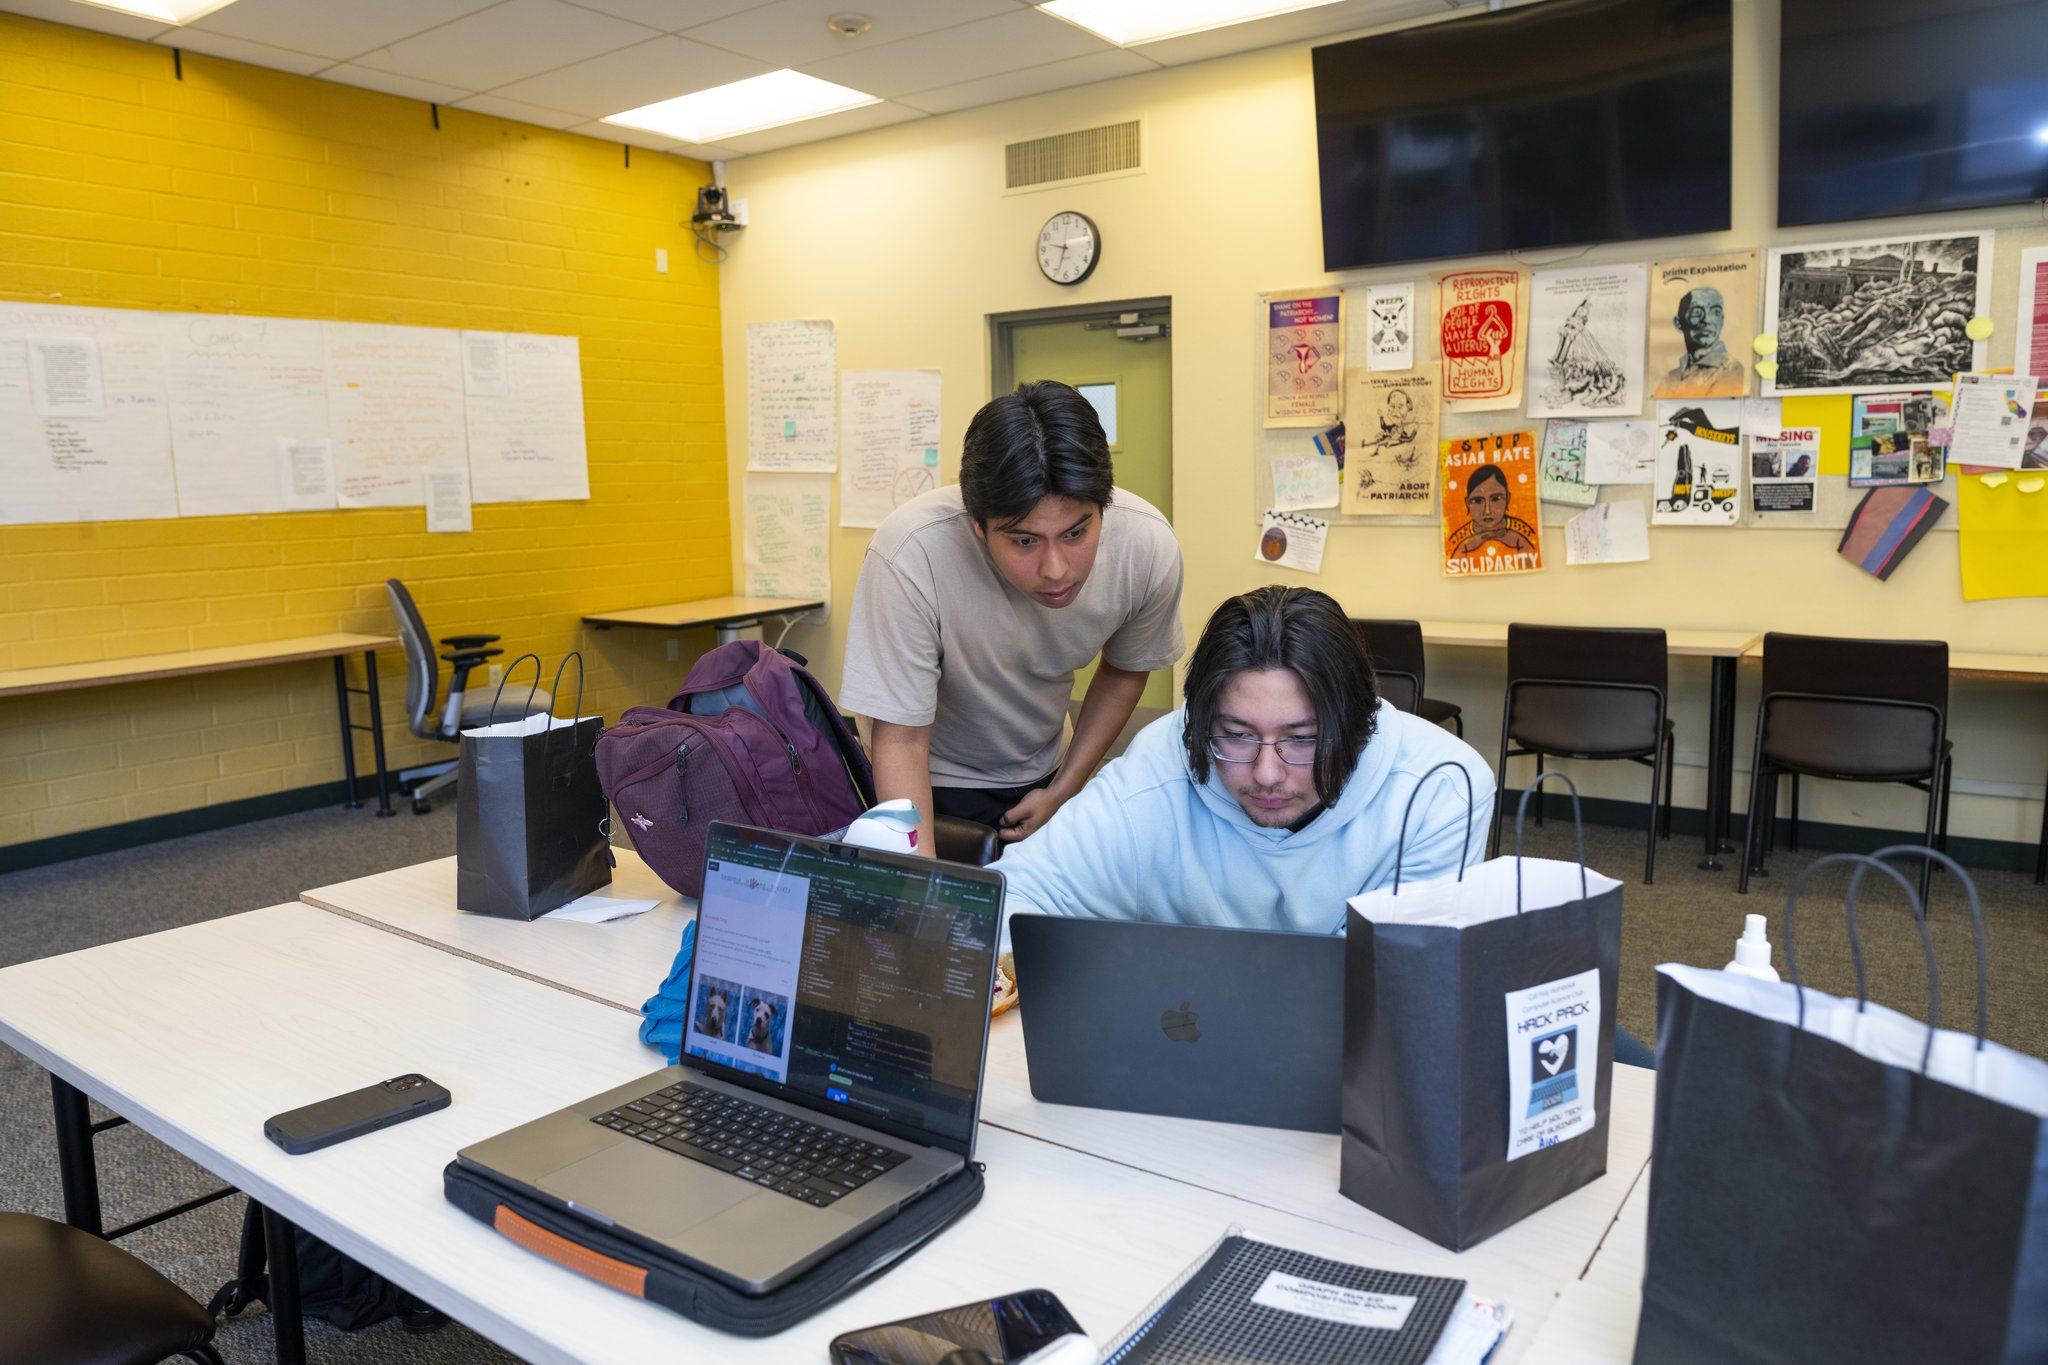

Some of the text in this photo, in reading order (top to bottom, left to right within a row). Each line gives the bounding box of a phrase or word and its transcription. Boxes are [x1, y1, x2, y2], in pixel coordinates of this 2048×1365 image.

[1062, 215, 1071, 224] 12
[1043, 232, 1051, 241] 10
[1041, 246, 1046, 255] 9
[1063, 270, 1069, 279] 6
[1075, 266, 1080, 276] 5
[1662, 263, 1747, 279] prime Exploitation
[1453, 275, 1517, 291] REPRODUCTIVE
[1457, 286, 1501, 302] RIGHTS
[1376, 297, 1403, 305] SWEEPS
[1469, 303, 1481, 315] OF
[1294, 316, 1306, 324] NOT
[1445, 315, 1479, 332] PEOPLE
[1444, 326, 1474, 342] HAVE
[1446, 340, 1489, 353] A UTERUS
[1458, 367, 1494, 378] HUMAN
[1453, 377, 1499, 389] RIGHTS
[1695, 426, 1736, 445] HOUSEKEYS
[1755, 430, 1813, 443] MSING
[1461, 433, 1520, 452] STOP
[1445, 446, 1531, 467] ASIAN HATE
[1557, 448, 1580, 462] IS
[1370, 492, 1430, 500] PATRIARCHY
[1674, 484, 1692, 495] NOT
[1446, 552, 1538, 573] SOLIDARITY
[1517, 1000, 1589, 1034] HACK PACK
[1530, 1119, 1547, 1130] HELP
[1549, 1113, 1563, 1123] YOU
[1565, 1105, 1582, 1116] TECH
[1547, 1116, 1582, 1134] BUSINESS
[1298, 1282, 1340, 1295] GRAPH
[1275, 1284, 1360, 1306] COMPOSITION
[1364, 1302, 1398, 1311] BOOK
